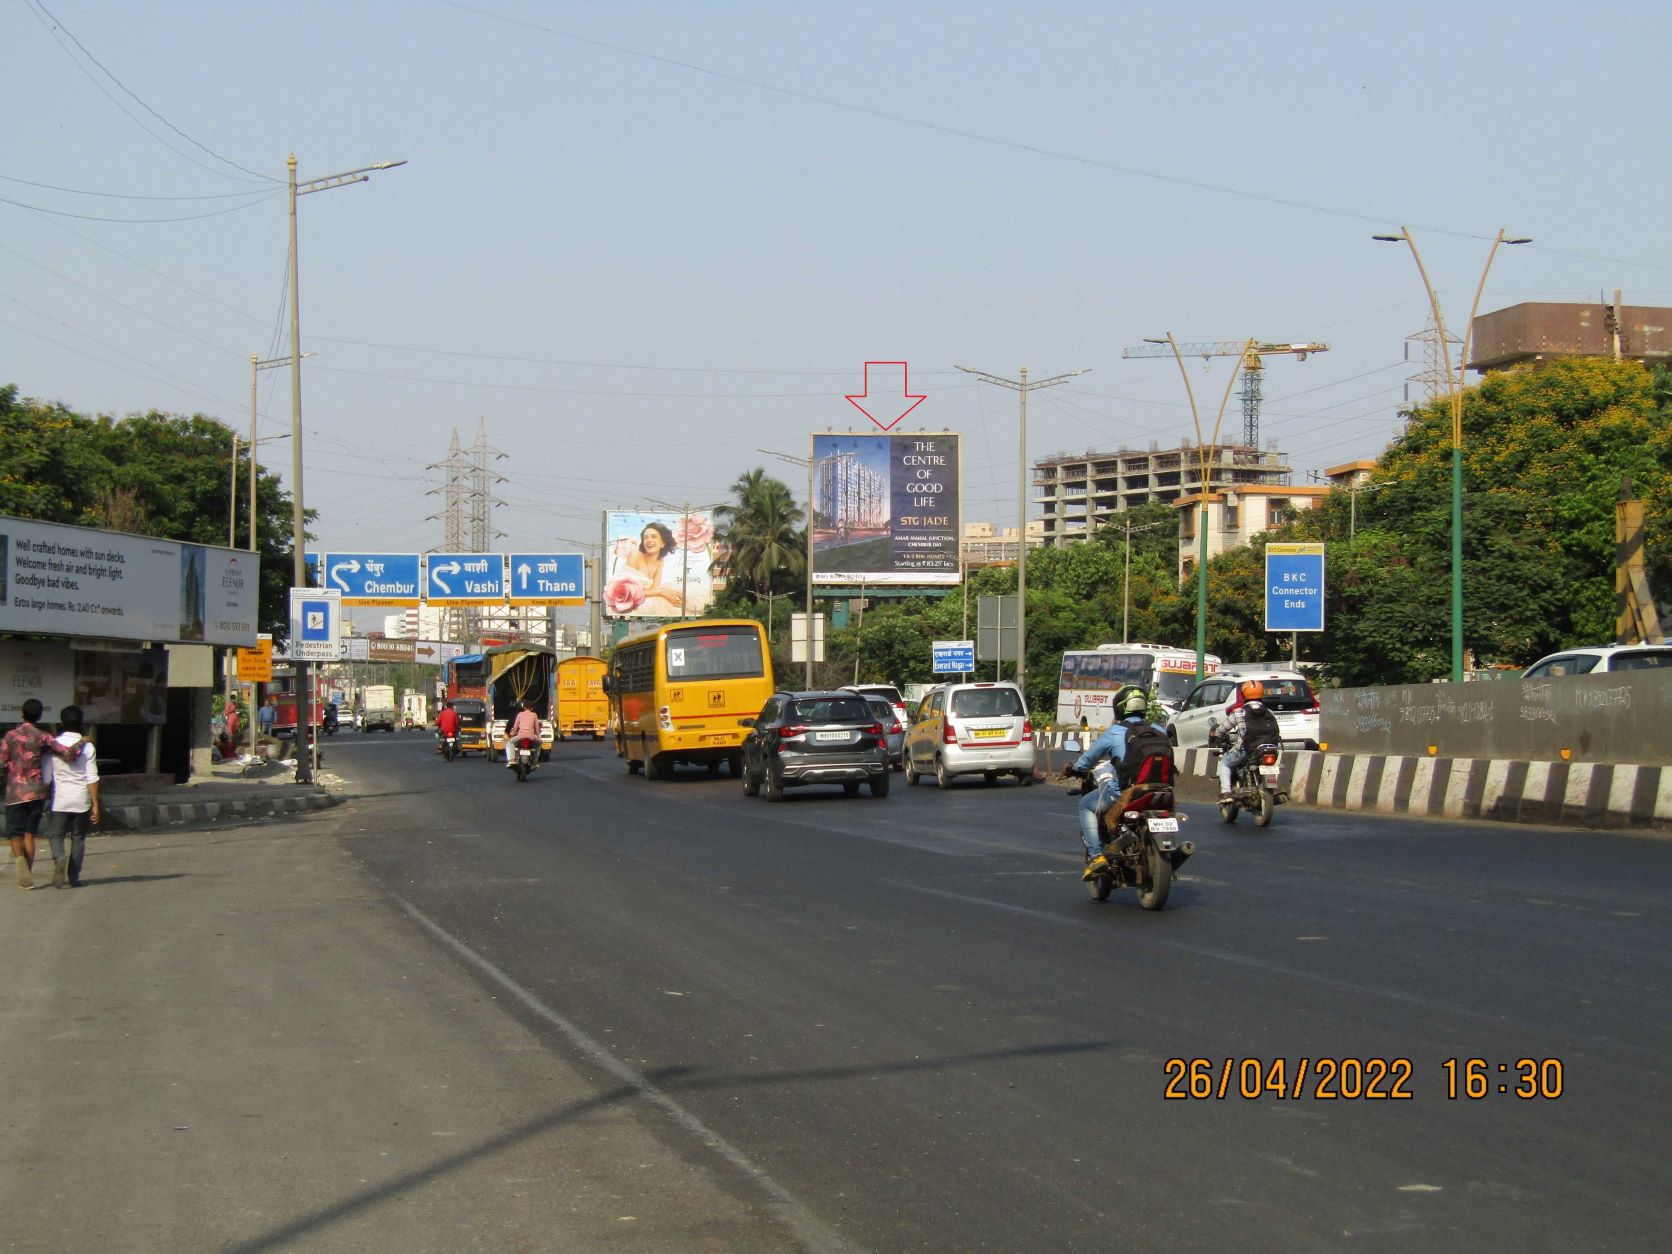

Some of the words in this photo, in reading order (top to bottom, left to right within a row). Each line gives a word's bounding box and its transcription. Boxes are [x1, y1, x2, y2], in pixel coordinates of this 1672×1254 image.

[914, 441, 936, 452] THE
[903, 455, 947, 466] CENTRE
[916, 469, 933, 480] OF
[906, 482, 943, 494] GOOD
[914, 496, 936, 507] LIFE
[16, 538, 30, 552] Well
[32, 541, 56, 555] crafted
[57, 543, 78, 557] homes
[80, 546, 94, 559] with
[95, 551, 105, 561] sun
[107, 549, 125, 563] decks.
[16, 556, 46, 571] Welcome
[48, 558, 64, 573] fresh
[65, 561, 74, 574] air
[75, 563, 88, 575] and
[88, 564, 107, 579] bright
[108, 566, 124, 581] light.
[463, 559, 488, 573] वाशी
[537, 559, 558, 574] ठाणे
[15, 573, 45, 589] Goodbye
[47, 575, 60, 589] bad
[61, 577, 80, 591] vibes.
[364, 580, 415, 594] Chembur
[464, 580, 499, 593] Vashi
[537, 579, 576, 592] Thane
[1272, 586, 1318, 595] Connector
[14, 596, 30, 608] Extra
[31, 597, 46, 611] large
[1284, 599, 1306, 609] Ends
[296, 641, 333, 649] Pedestrian
[951, 660, 965, 671] Nagar
